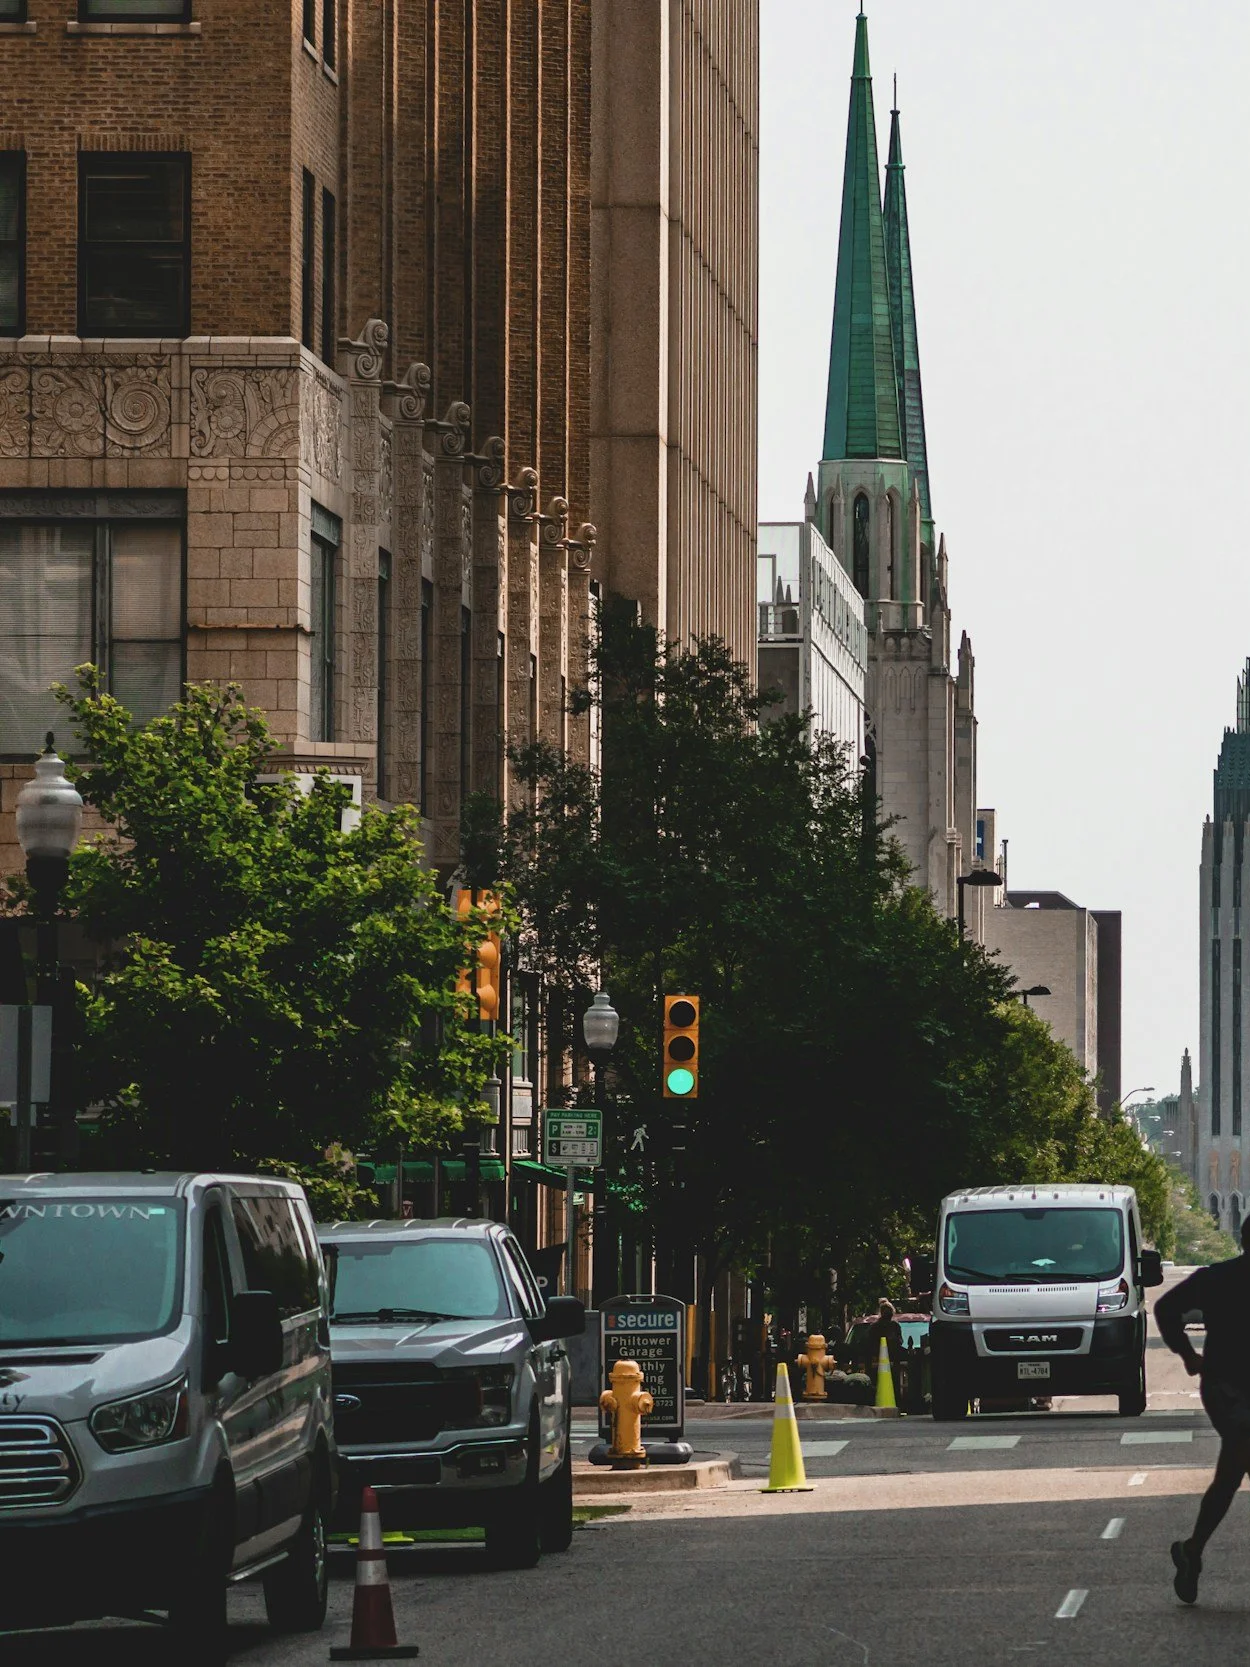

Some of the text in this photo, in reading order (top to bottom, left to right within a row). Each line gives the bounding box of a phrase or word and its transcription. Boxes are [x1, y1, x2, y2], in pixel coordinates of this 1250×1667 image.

[552, 1125, 558, 1134] P
[618, 1312, 674, 1328] secure
[610, 1336, 671, 1346] Philtower
[619, 1347, 663, 1358] Garage
